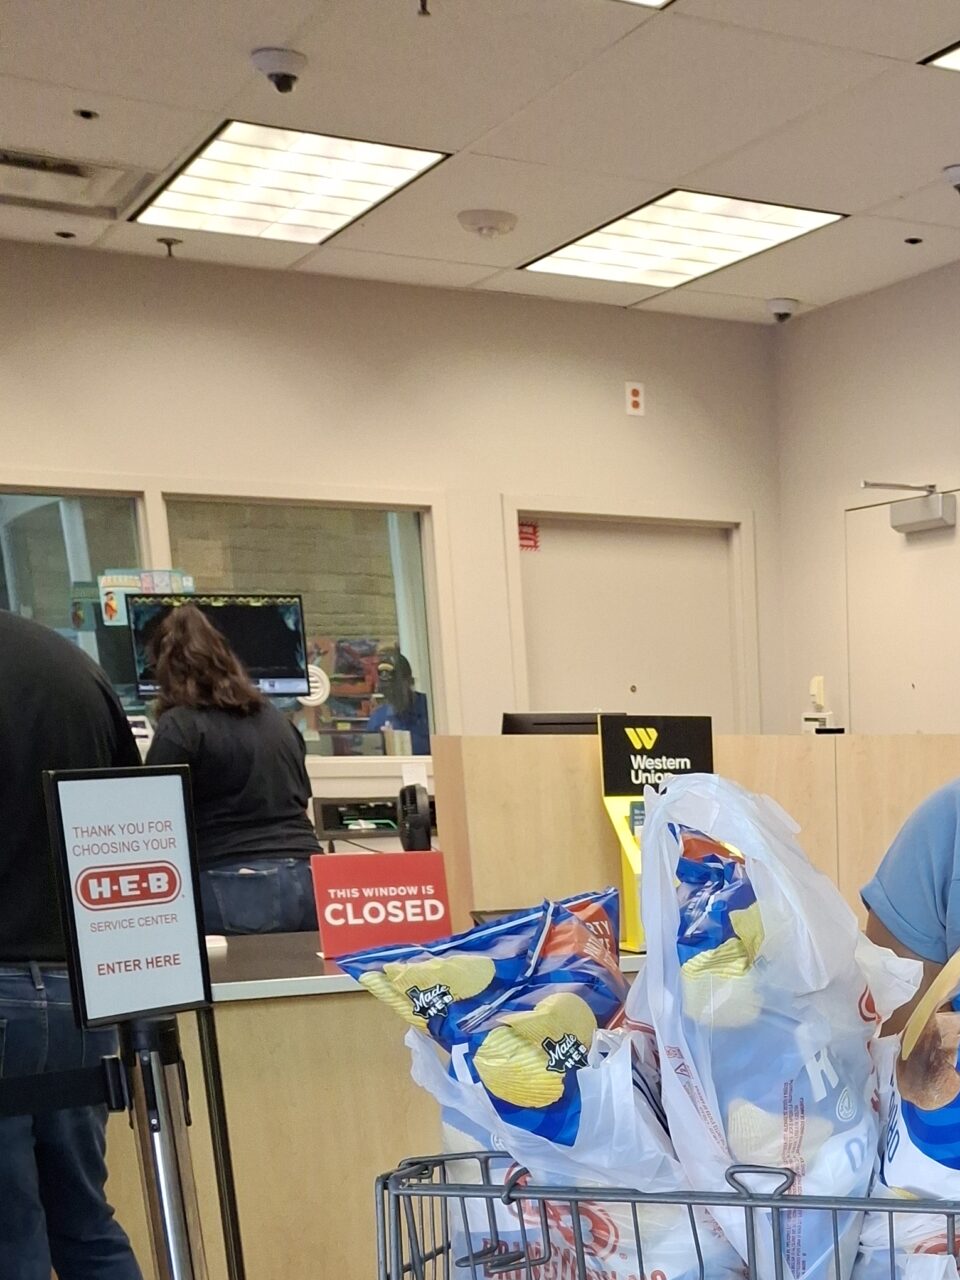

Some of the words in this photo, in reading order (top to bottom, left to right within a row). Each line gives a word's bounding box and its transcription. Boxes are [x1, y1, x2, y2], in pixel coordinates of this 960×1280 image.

[630, 754, 691, 769] Western
[72, 824, 115, 839] THANK
[118, 822, 145, 835] YOU
[149, 820, 173, 833] FOR
[72, 840, 140, 857] CHOOSING
[143, 837, 177, 850] YOUR
[327, 887, 359, 899] THIS
[361, 885, 418, 898] WINDOW
[421, 884, 435, 895] IS
[90, 917, 135, 932] SERVICE
[137, 913, 178, 928] CENTER
[324, 898, 445, 927] CLOSED
[97, 958, 142, 976] ENTER
[146, 953, 181, 969] HERE
[413, 984, 451, 1012] Made
[549, 1034, 577, 1065] Made
